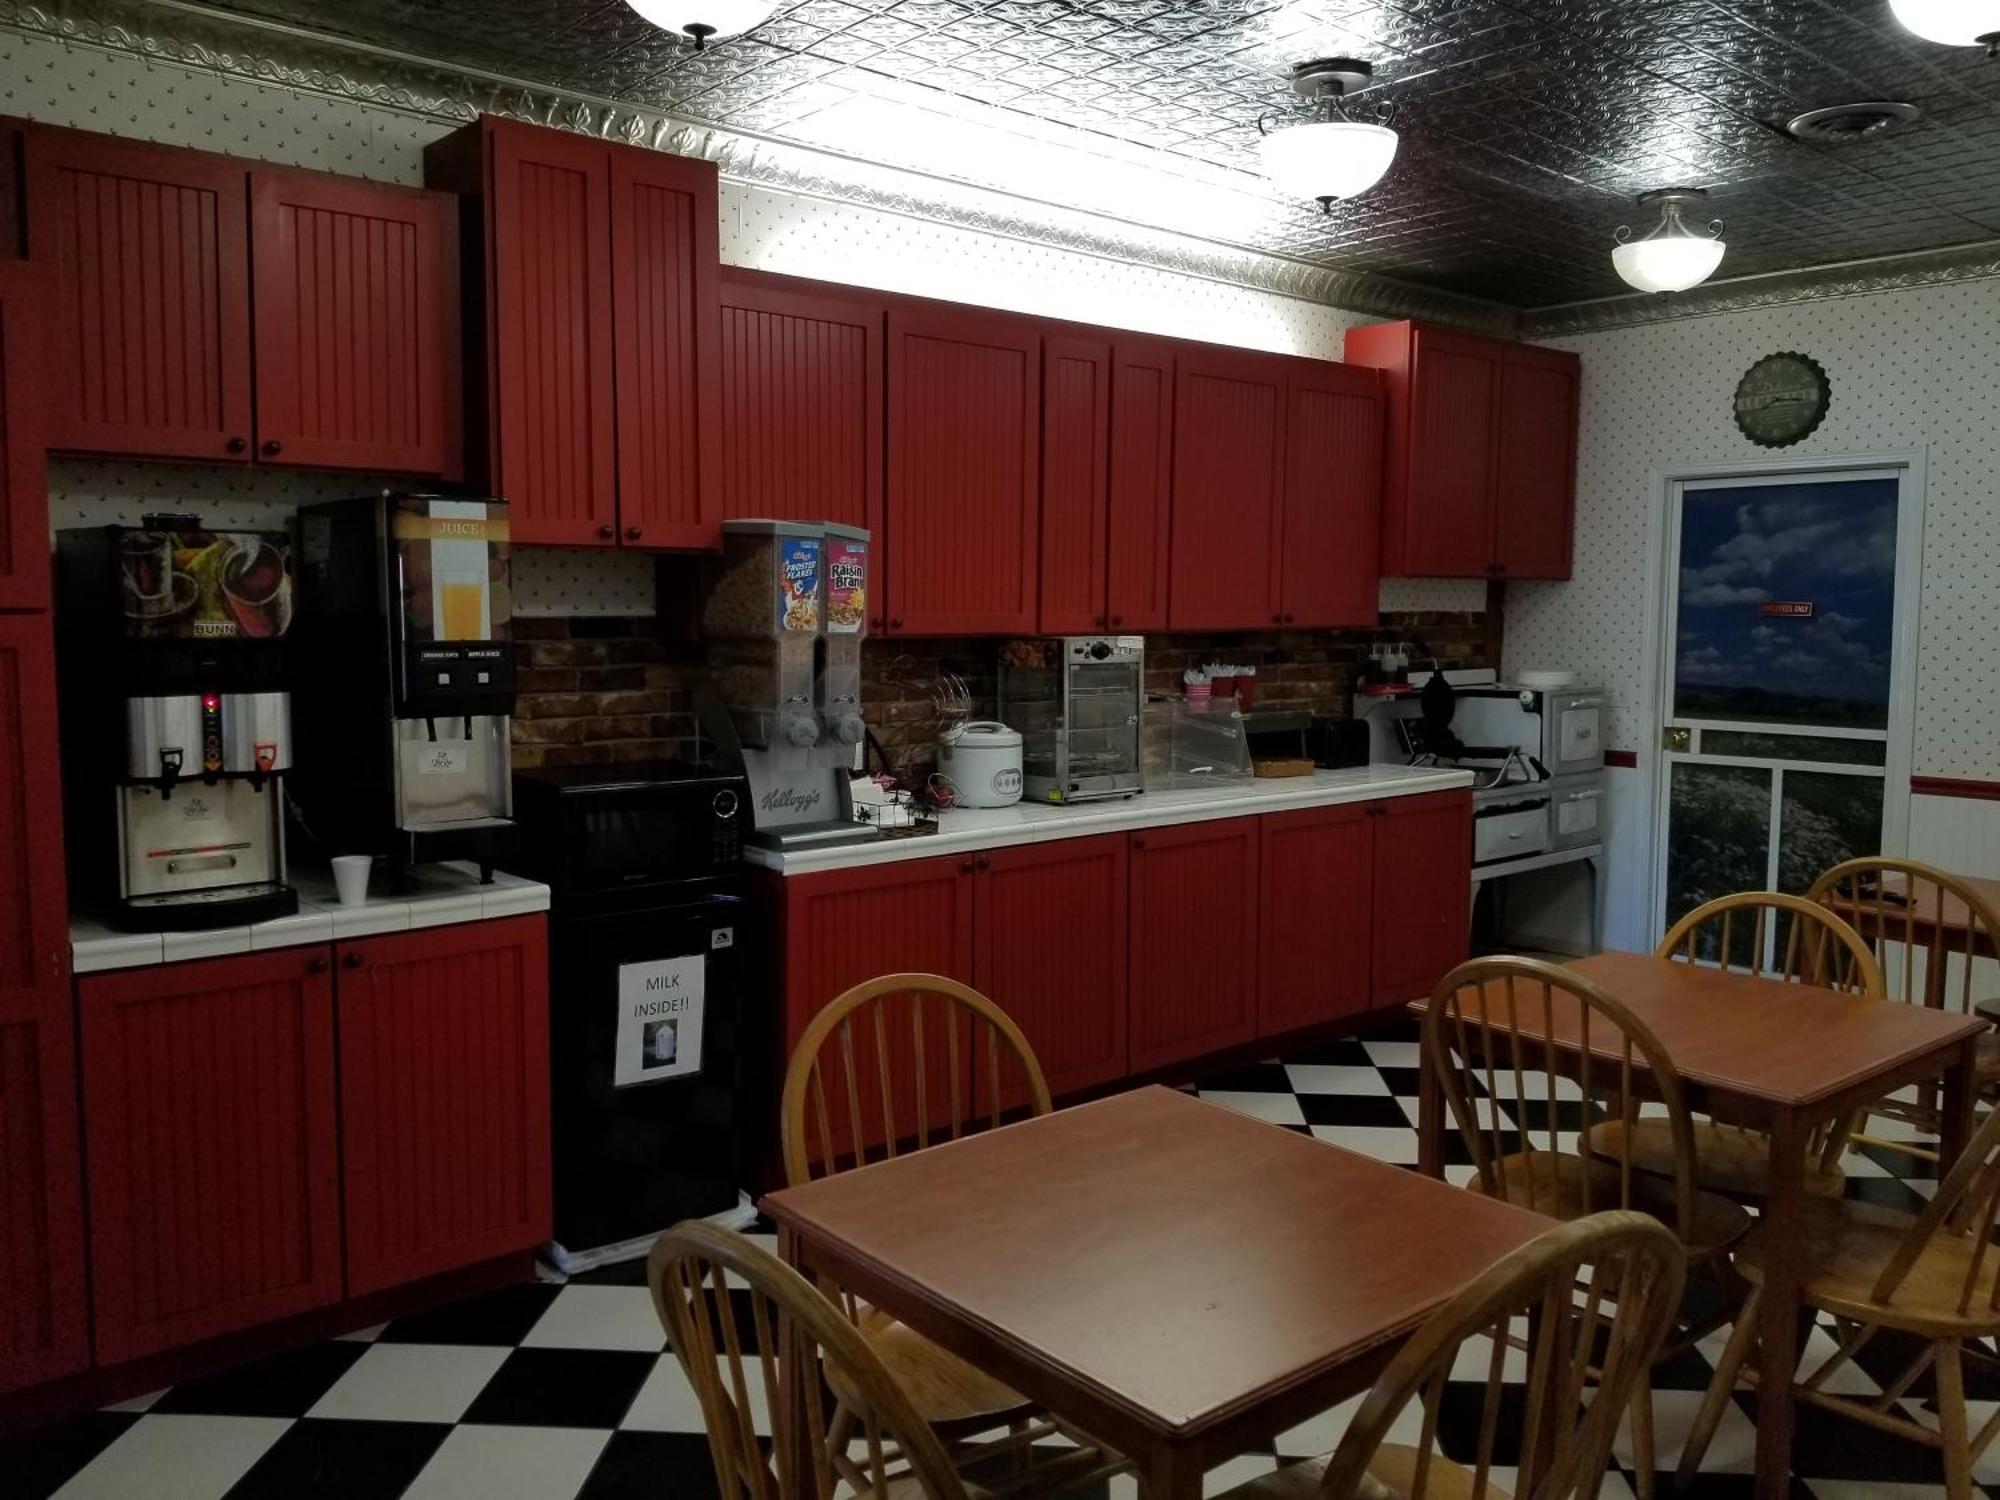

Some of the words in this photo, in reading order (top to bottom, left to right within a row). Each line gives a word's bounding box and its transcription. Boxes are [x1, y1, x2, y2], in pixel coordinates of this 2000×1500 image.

[440, 521, 480, 535] JUICE
[831, 565, 863, 577] Raisin
[834, 577, 860, 588] Bran
[195, 624, 234, 635] BUNN
[762, 789, 820, 812] Kellogg's
[646, 974, 680, 991] MILK
[634, 997, 689, 1018] INSIDE!!
